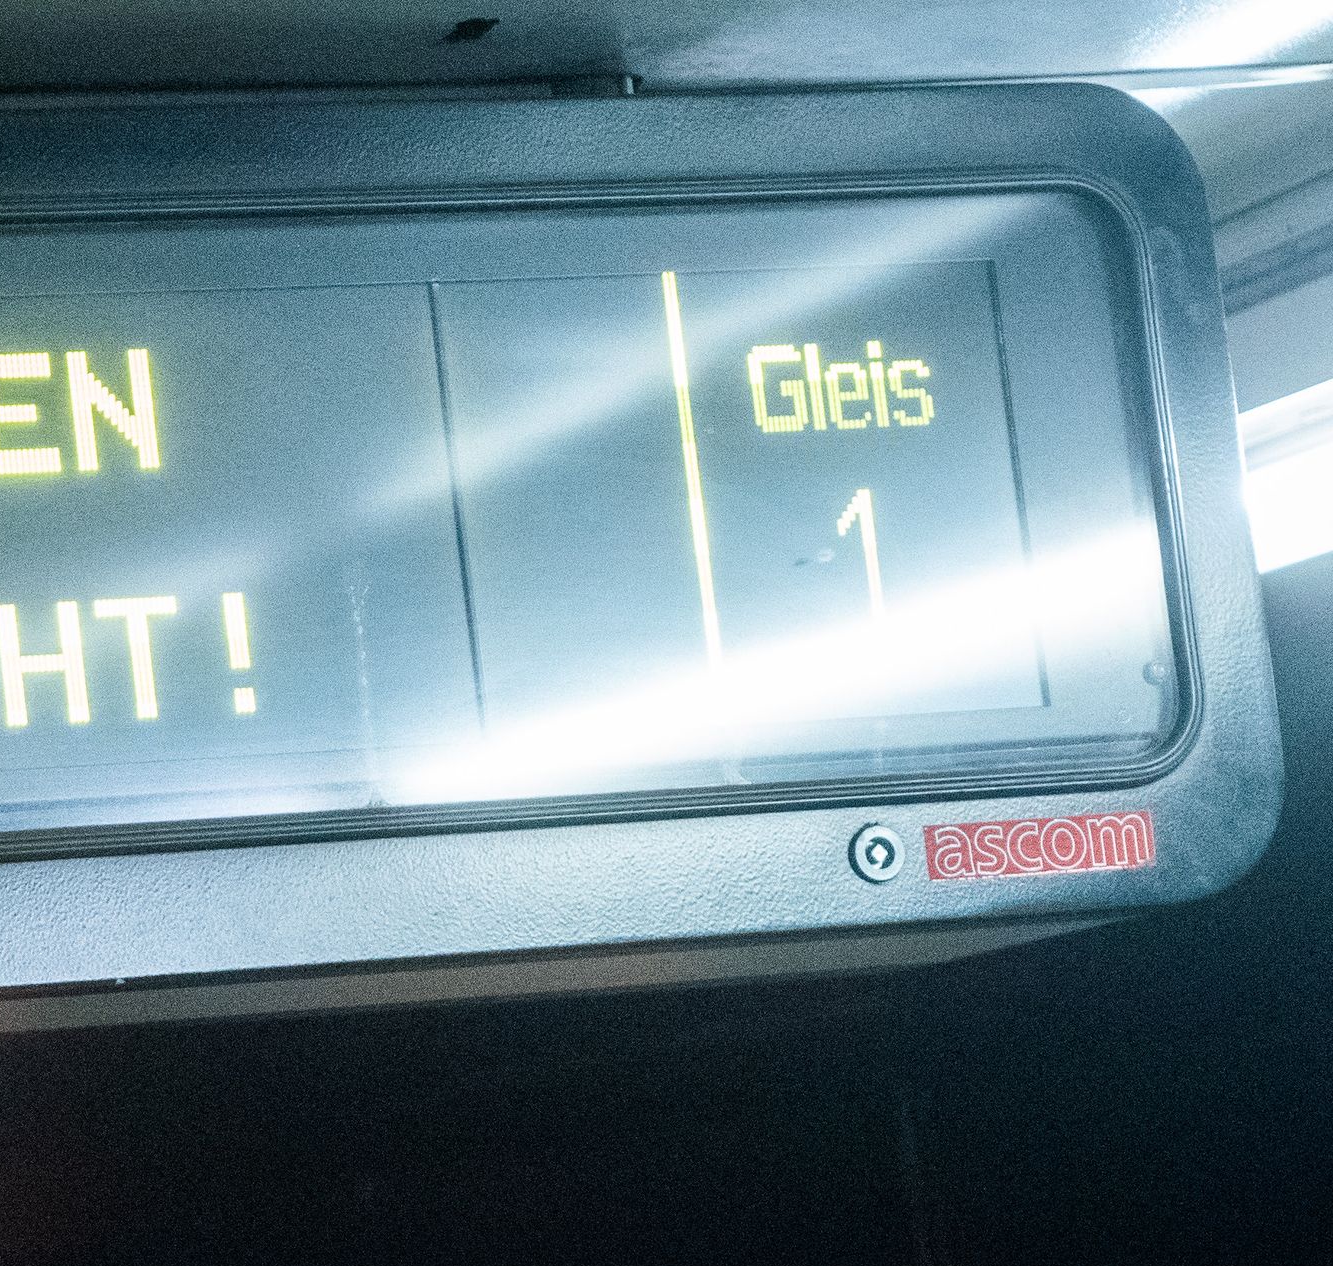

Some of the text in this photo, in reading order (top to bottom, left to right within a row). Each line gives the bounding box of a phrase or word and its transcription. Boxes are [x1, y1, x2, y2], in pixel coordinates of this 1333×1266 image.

[747, 340, 935, 433] Gleis
[836, 488, 883, 617] 1
[935, 813, 1151, 878] ascom
